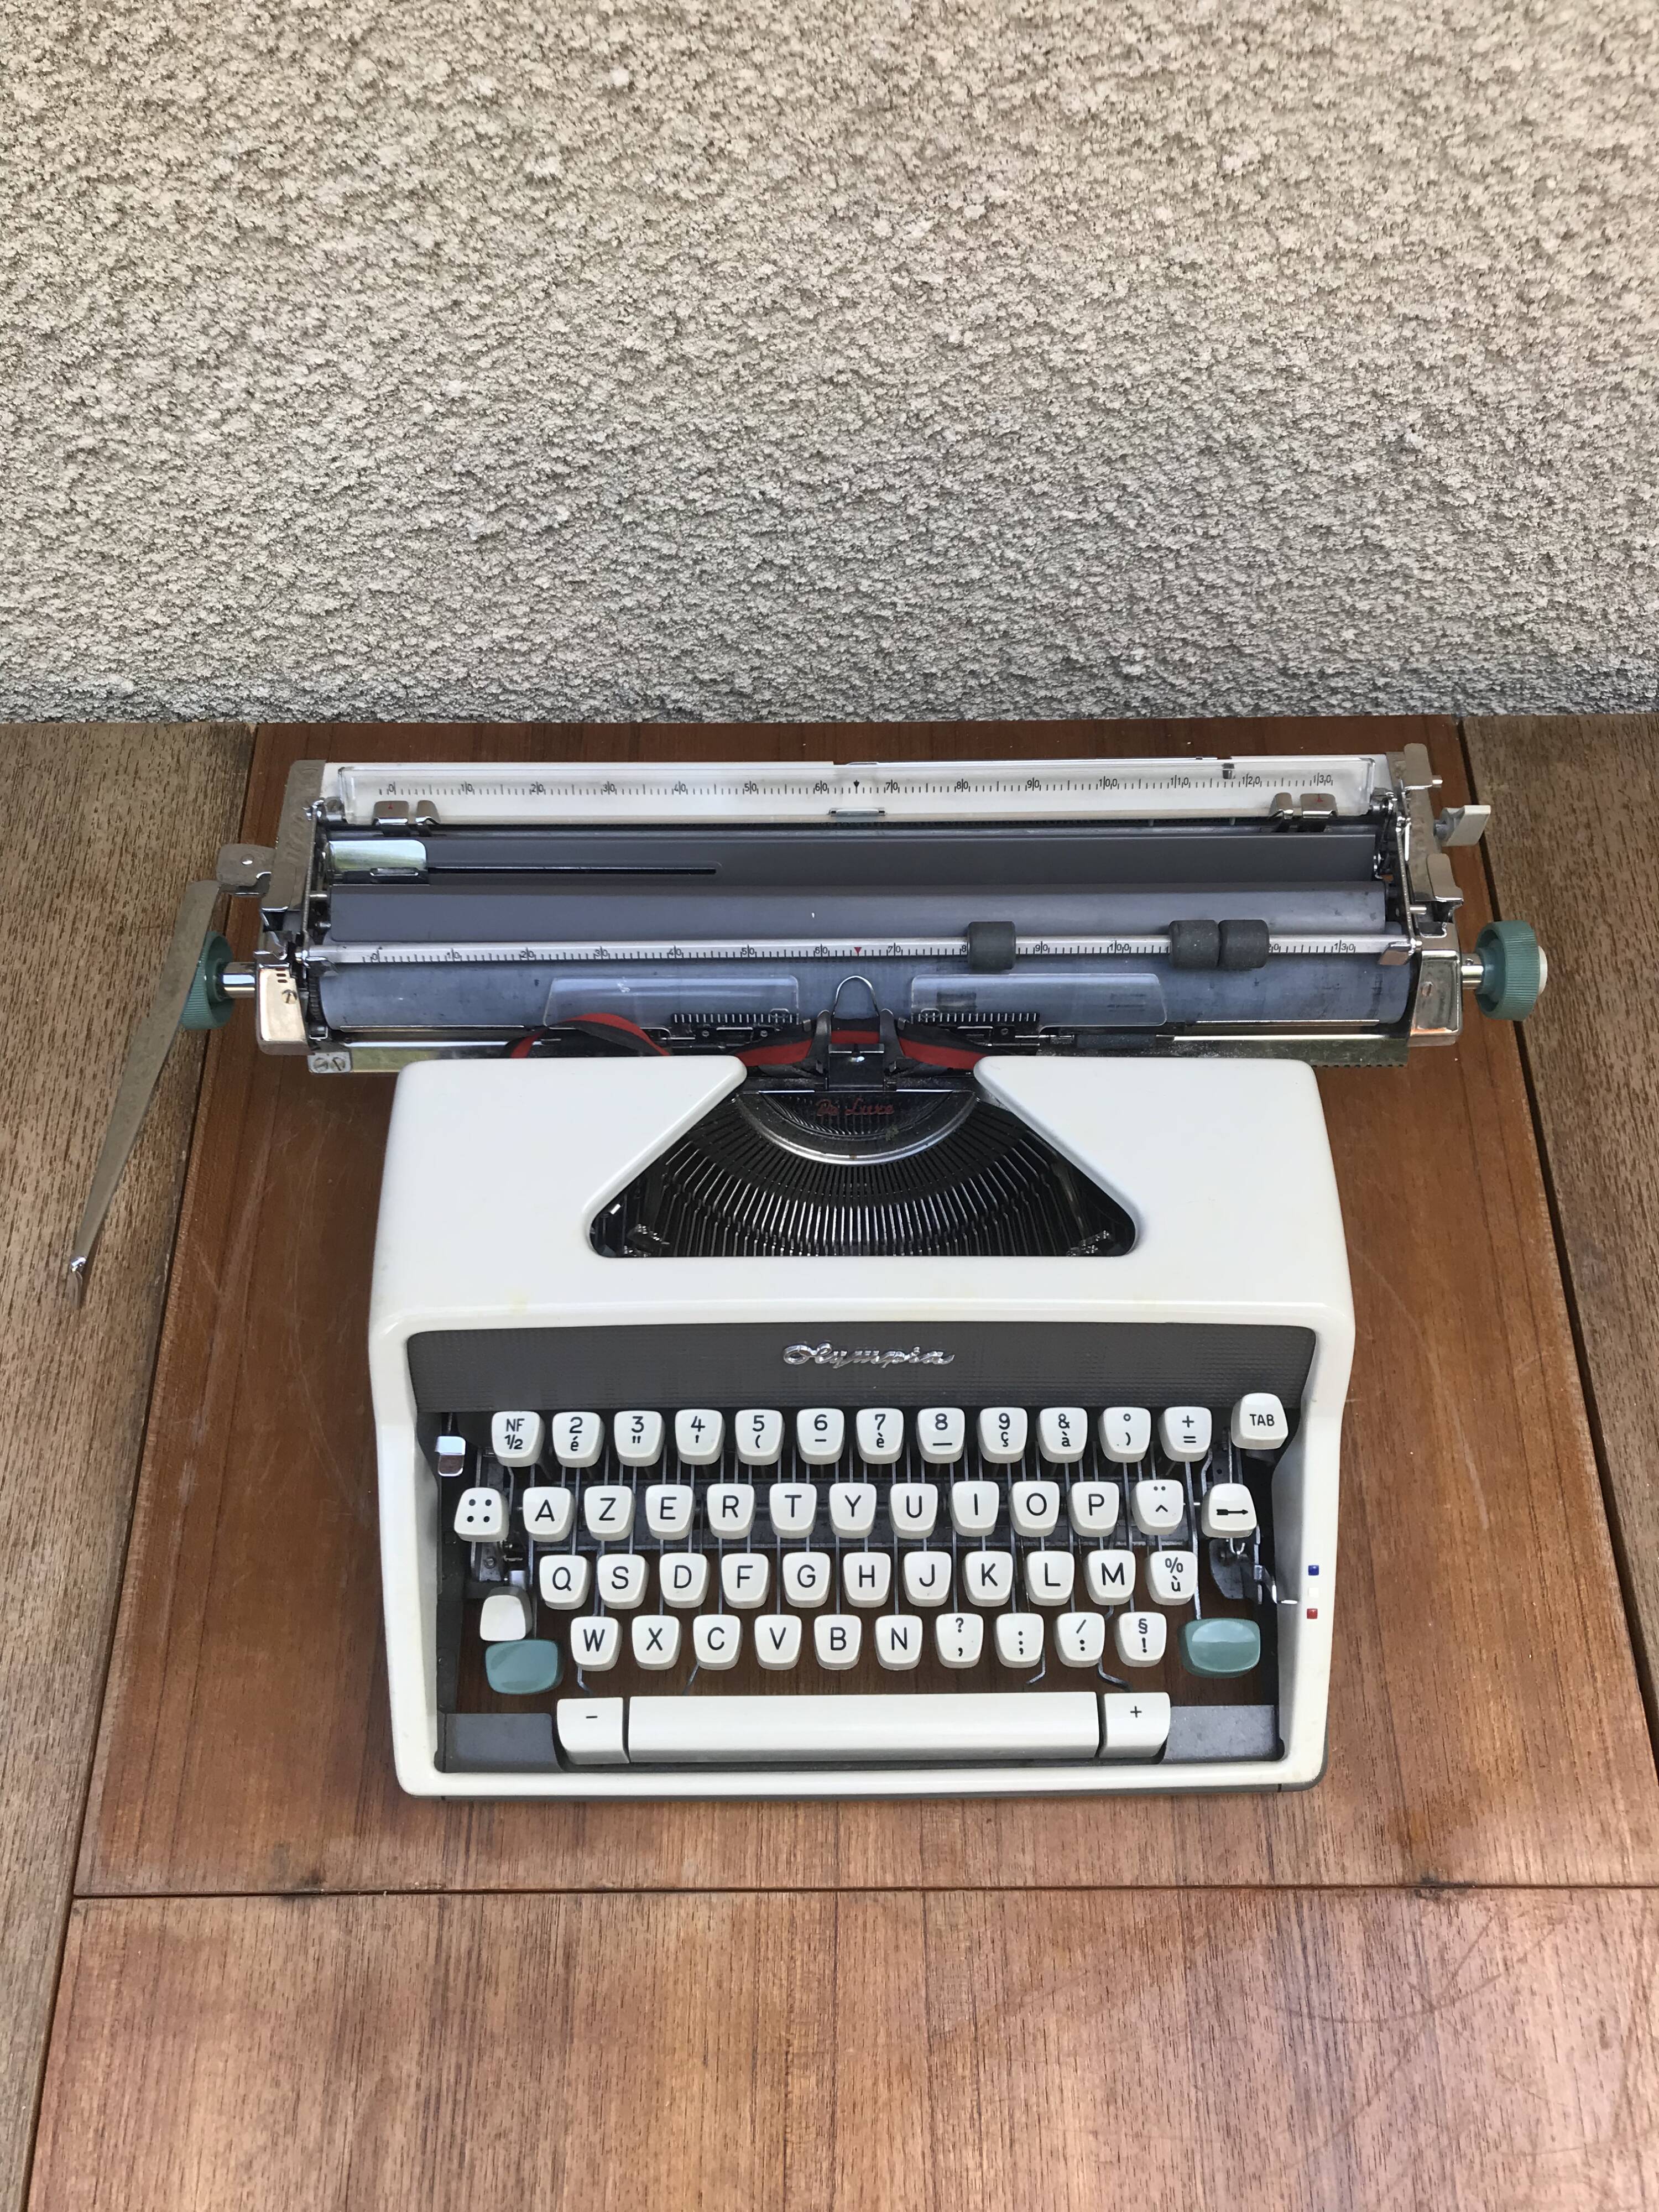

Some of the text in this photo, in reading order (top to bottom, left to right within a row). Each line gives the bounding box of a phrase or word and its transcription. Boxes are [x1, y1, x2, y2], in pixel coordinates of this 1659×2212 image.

[388, 775, 1332, 793] 0 10 20 30 40 50 60 70 80 90 100 110 120 130
[594, 949, 608, 957] 30
[742, 947, 755, 956] 50
[815, 946, 828, 954] 60
[888, 945, 901, 953] 70
[1035, 943, 1048, 952] 90
[1108, 943, 1130, 951] 100
[1333, 942, 1354, 951] 130
[783, 1341, 956, 1369] Olympia
[506, 1418, 525, 1432] NF
[569, 1416, 583, 1434] 2
[631, 1416, 644, 1433] 3
[690, 1416, 706, 1432] 4
[752, 1415, 765, 1432] 5
[814, 1414, 828, 1431] 6
[874, 1413, 886, 1431] 7
[935, 1413, 948, 1431] 8
[999, 1412, 1010, 1430] 9
[1058, 1413, 1070, 1429] &
[1182, 1415, 1194, 1428] +
[1249, 1413, 1275, 1427] TAB
[570, 1436, 579, 1452] é
[755, 1434, 761, 1449] (
[876, 1432, 885, 1448] è
[1001, 1431, 1009, 1447] ç
[1061, 1431, 1071, 1447] à
[1125, 1432, 1131, 1446] )
[535, 1499, 555, 1522] A
[598, 1498, 616, 1521] Z
[660, 1496, 677, 1520] E
[722, 1495, 739, 1518] R
[784, 1494, 802, 1518] T
[844, 1495, 862, 1517] Y
[906, 1495, 922, 1519] U
[1026, 1493, 1047, 1516] O
[1088, 1494, 1105, 1516] P
[1165, 1557, 1183, 1574] %
[552, 1562, 1181, 1592] Q S D F G H J K L M ù
[955, 1617, 964, 1633] ?
[1076, 1619, 1087, 1634] /
[1138, 1618, 1148, 1635] §
[583, 1627, 907, 1652] W X C V B N
[1141, 1637, 1147, 1653] !
[1130, 1705, 1142, 1718] +
